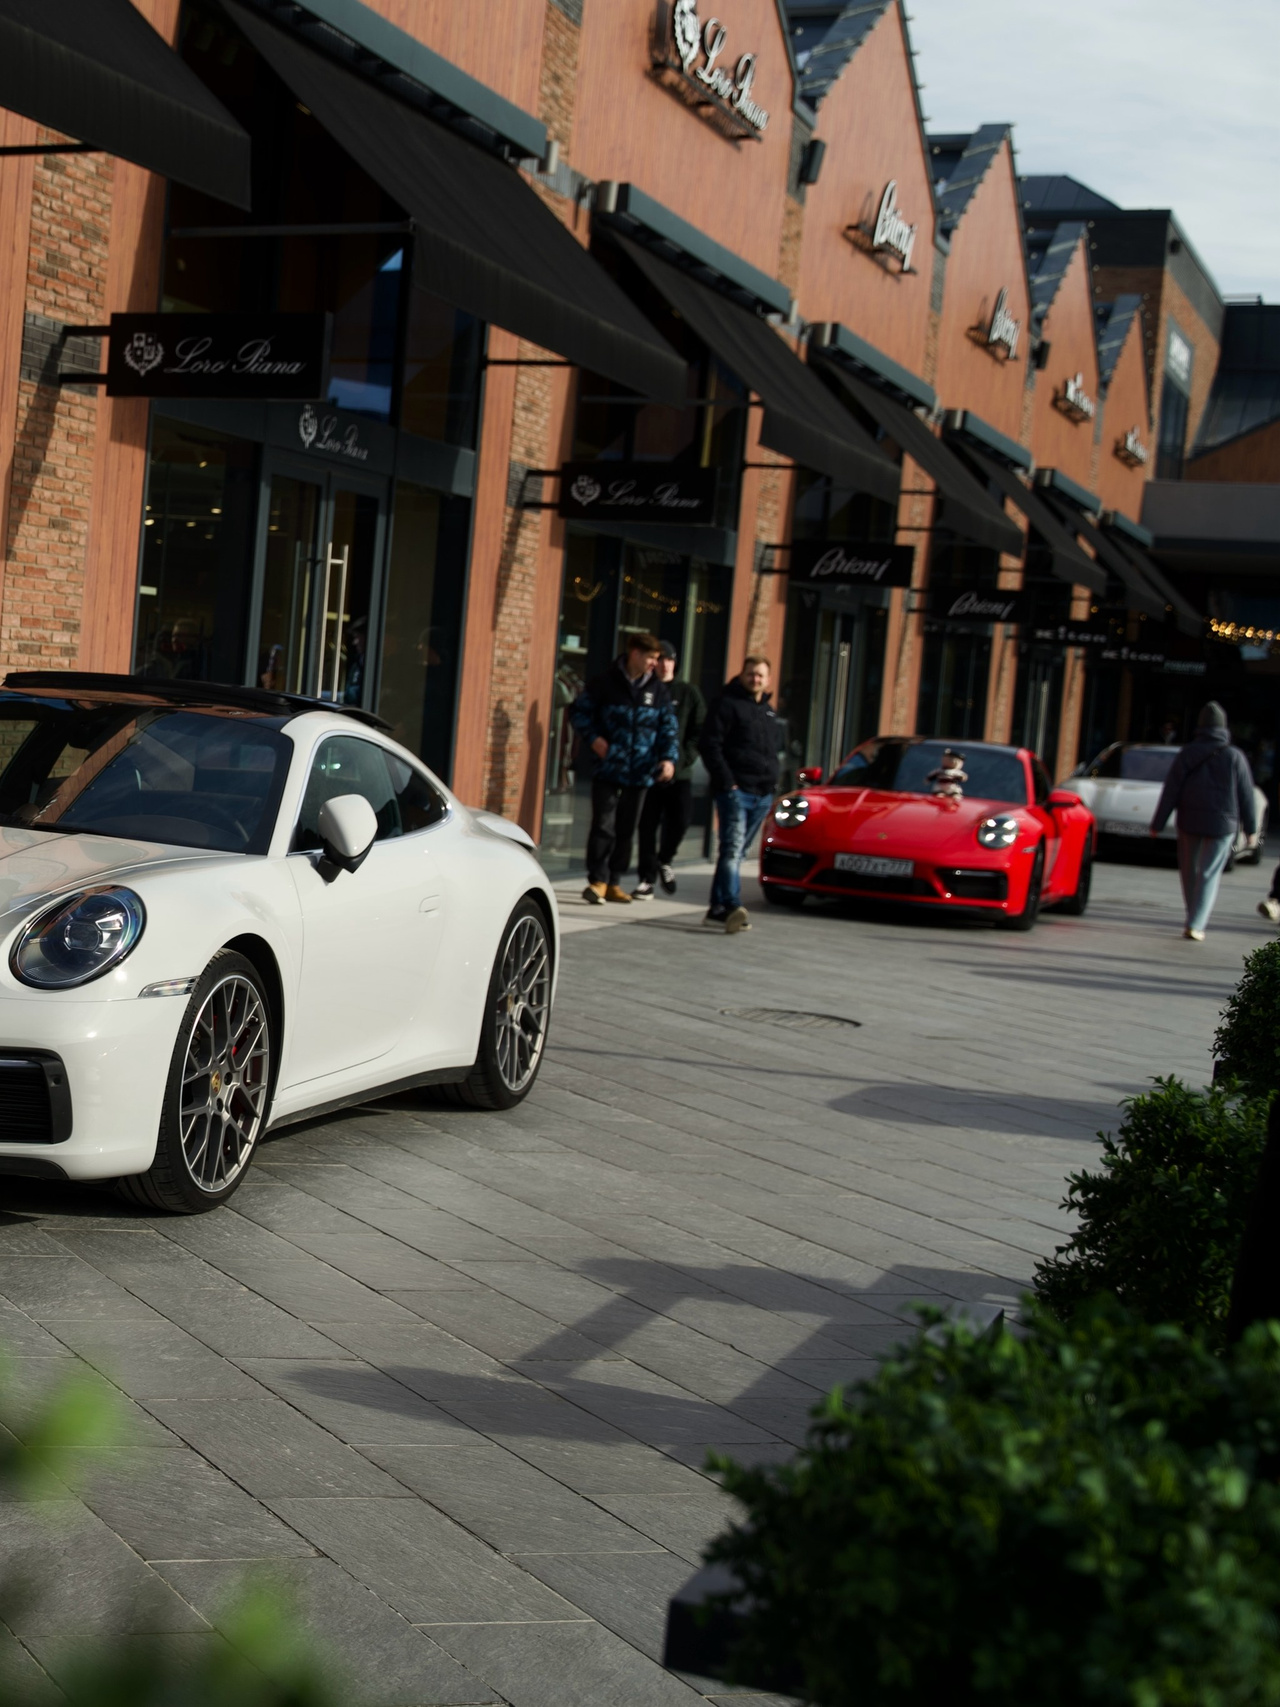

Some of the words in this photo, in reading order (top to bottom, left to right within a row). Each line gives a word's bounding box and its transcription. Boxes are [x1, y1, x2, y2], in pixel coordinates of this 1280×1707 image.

[696, 17, 733, 99] Loro
[164, 336, 229, 374] Loro
[232, 336, 306, 374] Piana
[314, 414, 342, 453] Loro
[342, 424, 369, 460] Piana
[599, 479, 648, 506] Loro
[649, 481, 702, 508] Piana
[810, 546, 892, 581] Brioni
